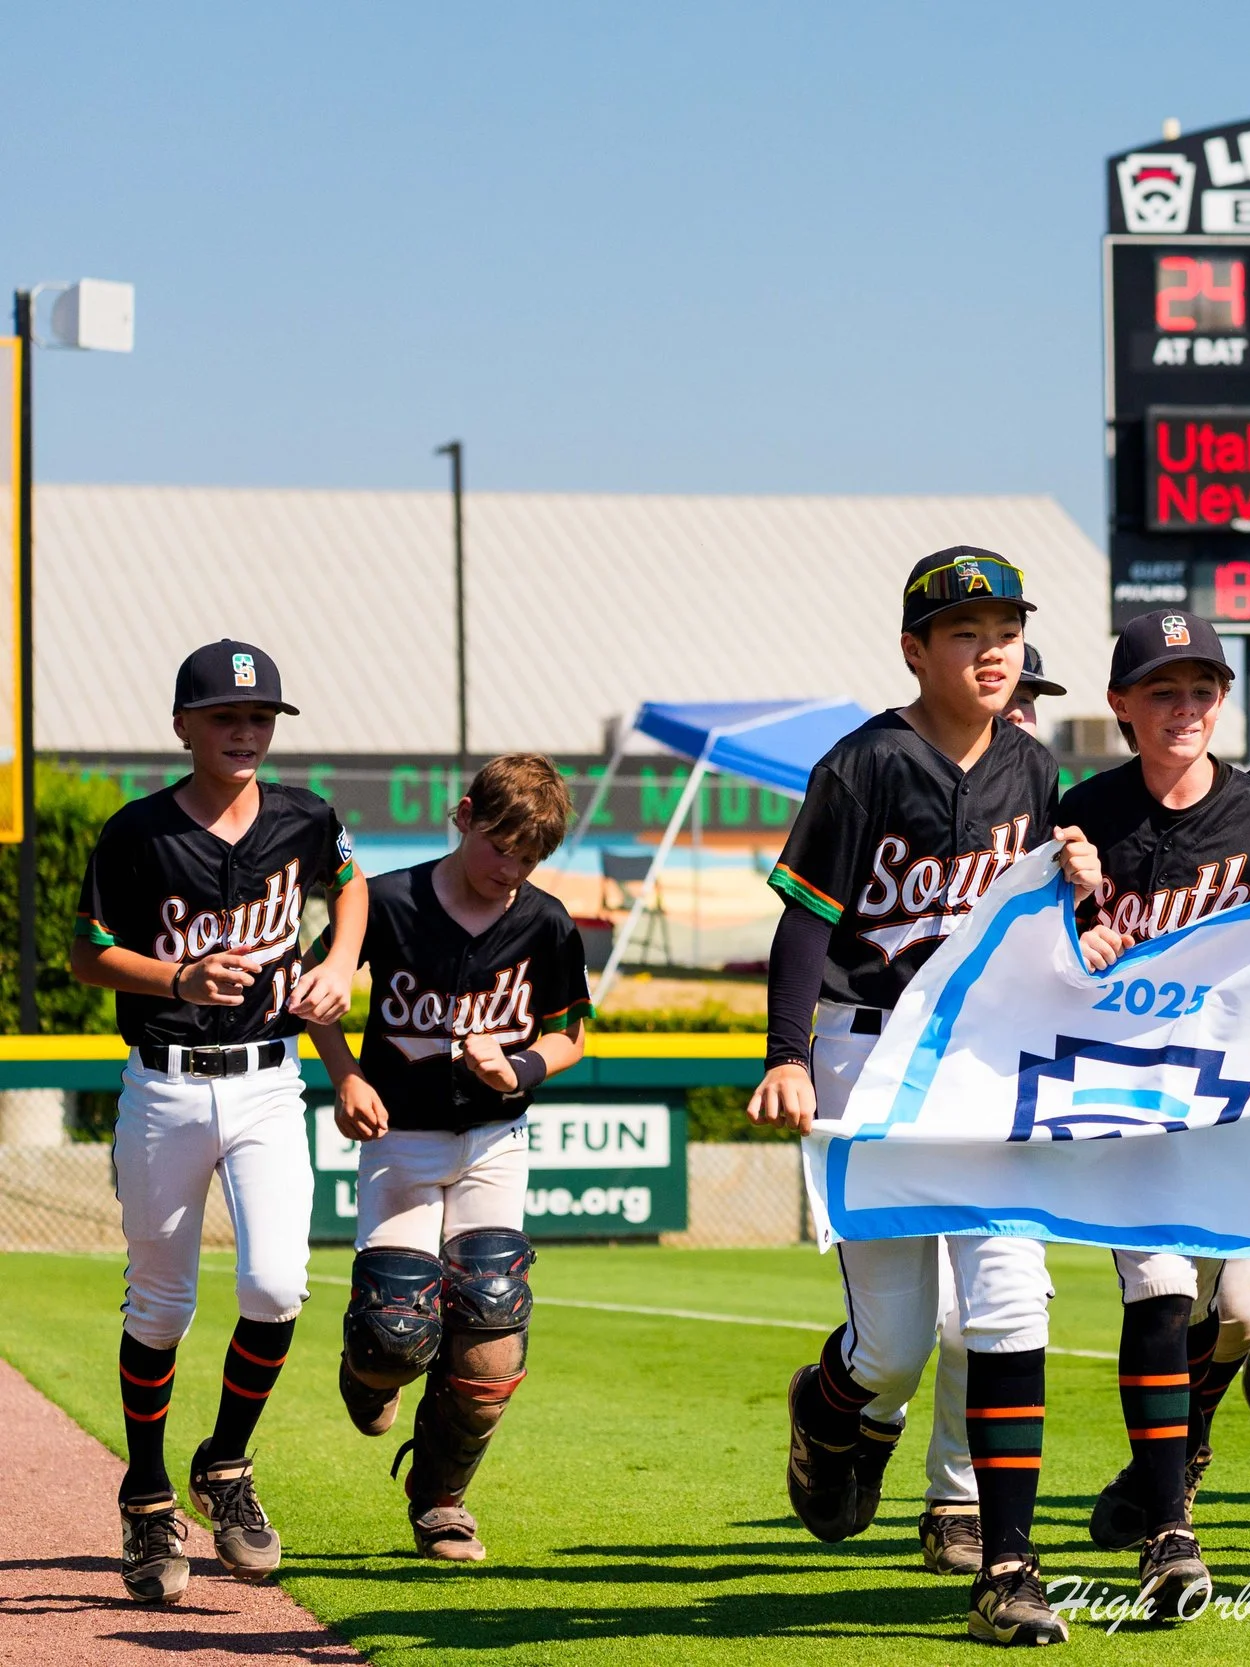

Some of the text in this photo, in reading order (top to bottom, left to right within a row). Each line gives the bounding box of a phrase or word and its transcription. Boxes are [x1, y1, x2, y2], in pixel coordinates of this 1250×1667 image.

[1155, 255, 1246, 332] 24
[1153, 338, 1248, 366] AT BAT
[154, 857, 301, 964] South
[381, 958, 535, 1037] South
[1092, 978, 1213, 1019] 2025
[561, 1121, 647, 1151] FUN
